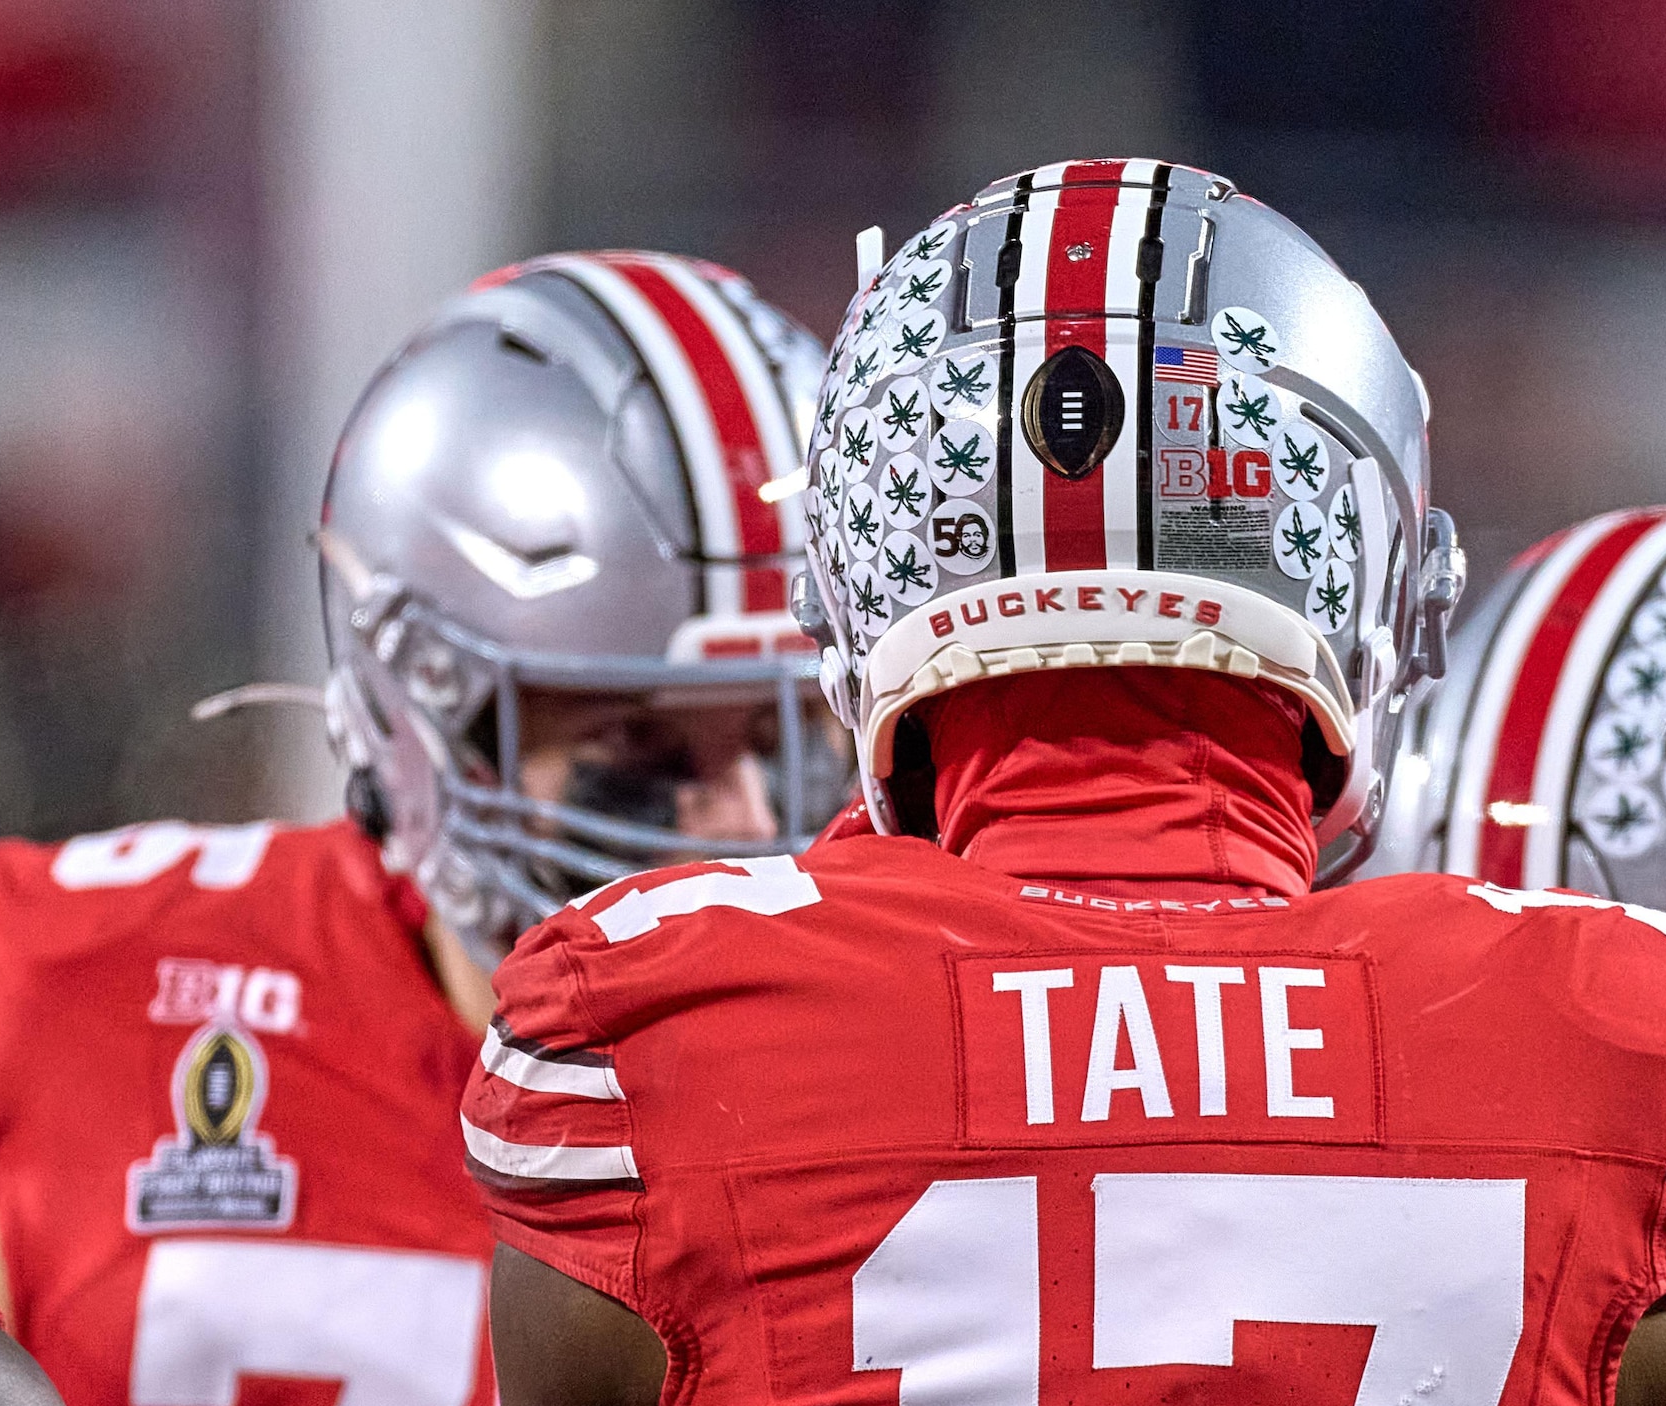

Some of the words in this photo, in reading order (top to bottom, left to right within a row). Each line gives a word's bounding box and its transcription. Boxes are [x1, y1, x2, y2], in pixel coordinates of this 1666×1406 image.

[1167, 395, 1205, 432] 17
[929, 586, 1223, 638] BUCKEYES
[1019, 884, 1291, 912] BUCKEYES
[991, 964, 1336, 1126] TATE
